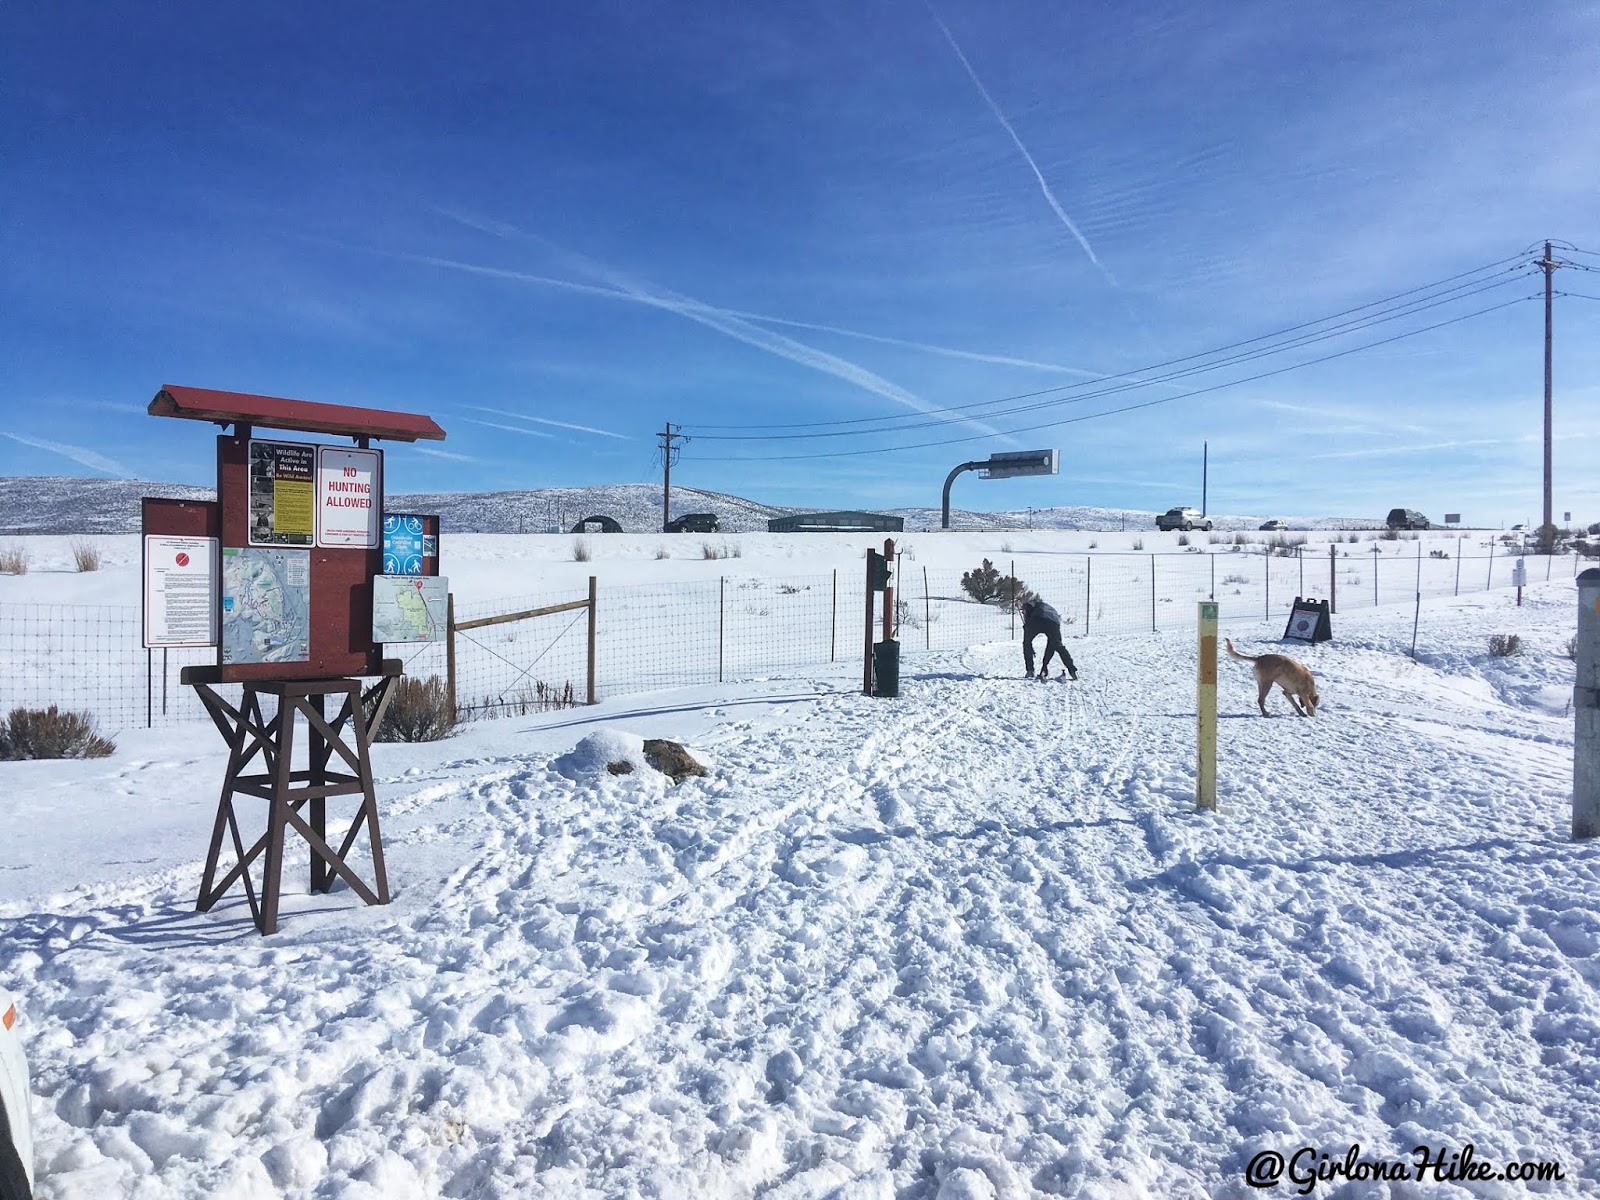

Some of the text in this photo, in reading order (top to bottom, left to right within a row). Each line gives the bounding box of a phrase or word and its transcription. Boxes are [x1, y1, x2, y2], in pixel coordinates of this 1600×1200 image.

[275, 449, 300, 457] Wildlife
[343, 467, 357, 478] NO
[328, 481, 371, 493] HUNTING
[326, 497, 372, 509] ALLOWED
